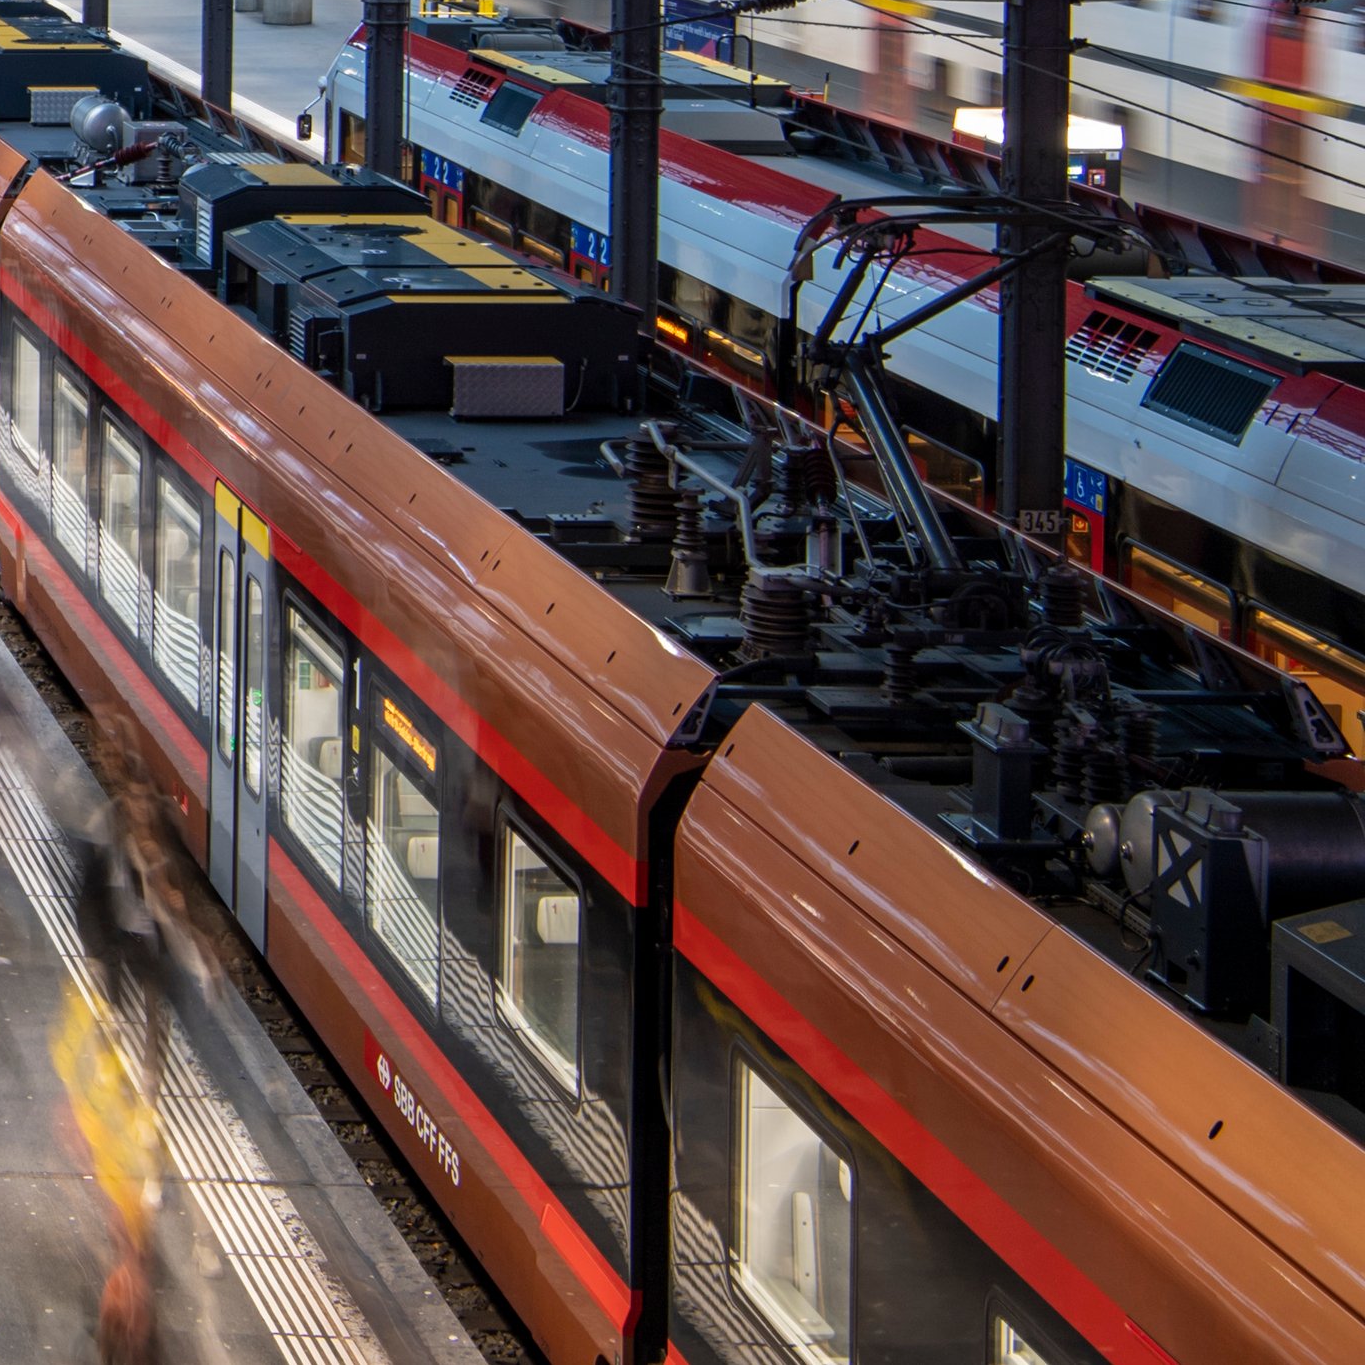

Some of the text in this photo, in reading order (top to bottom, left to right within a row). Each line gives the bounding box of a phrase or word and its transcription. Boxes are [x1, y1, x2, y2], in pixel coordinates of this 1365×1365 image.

[433, 157, 449, 185] 2 2
[588, 233, 607, 265] 2 2
[1025, 511, 1055, 533] 345
[394, 1075, 459, 1187] SBB CFF FFS
